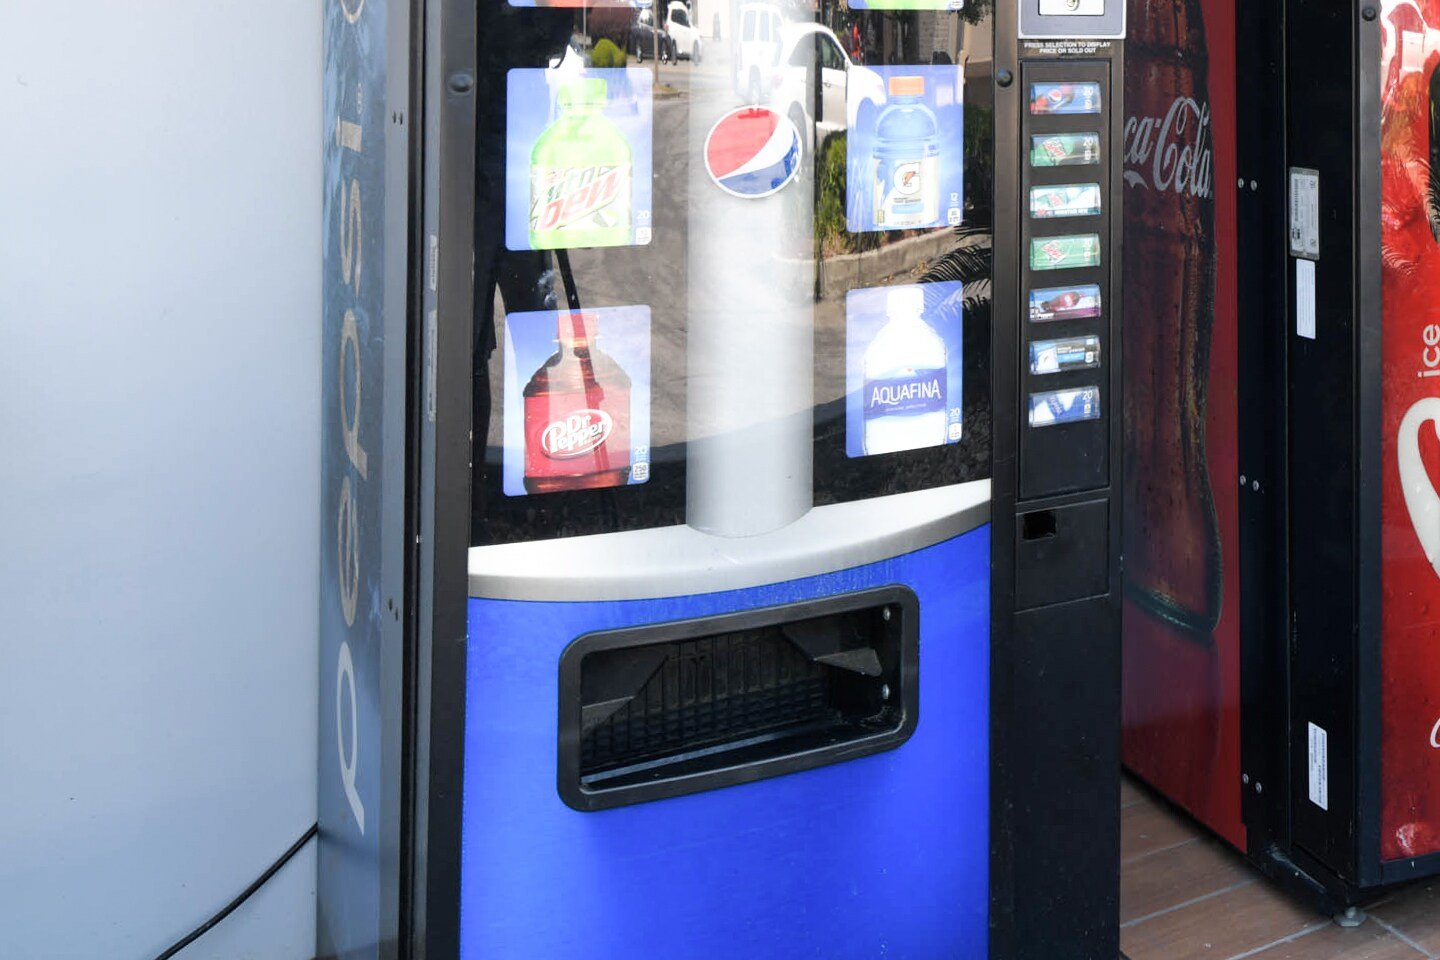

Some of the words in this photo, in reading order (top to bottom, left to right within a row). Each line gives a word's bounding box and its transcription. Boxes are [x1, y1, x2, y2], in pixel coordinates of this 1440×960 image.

[1122, 95, 1211, 199] ca-Cola
[894, 163, 921, 195] G
[637, 210, 650, 220] 20
[870, 378, 942, 408] AQUAFINA
[1082, 390, 1093, 401] 20
[549, 421, 608, 454] Pepper
[568, 414, 591, 431] Dr
[634, 445, 647, 454] 20
[335, 115, 369, 837] pepsi
